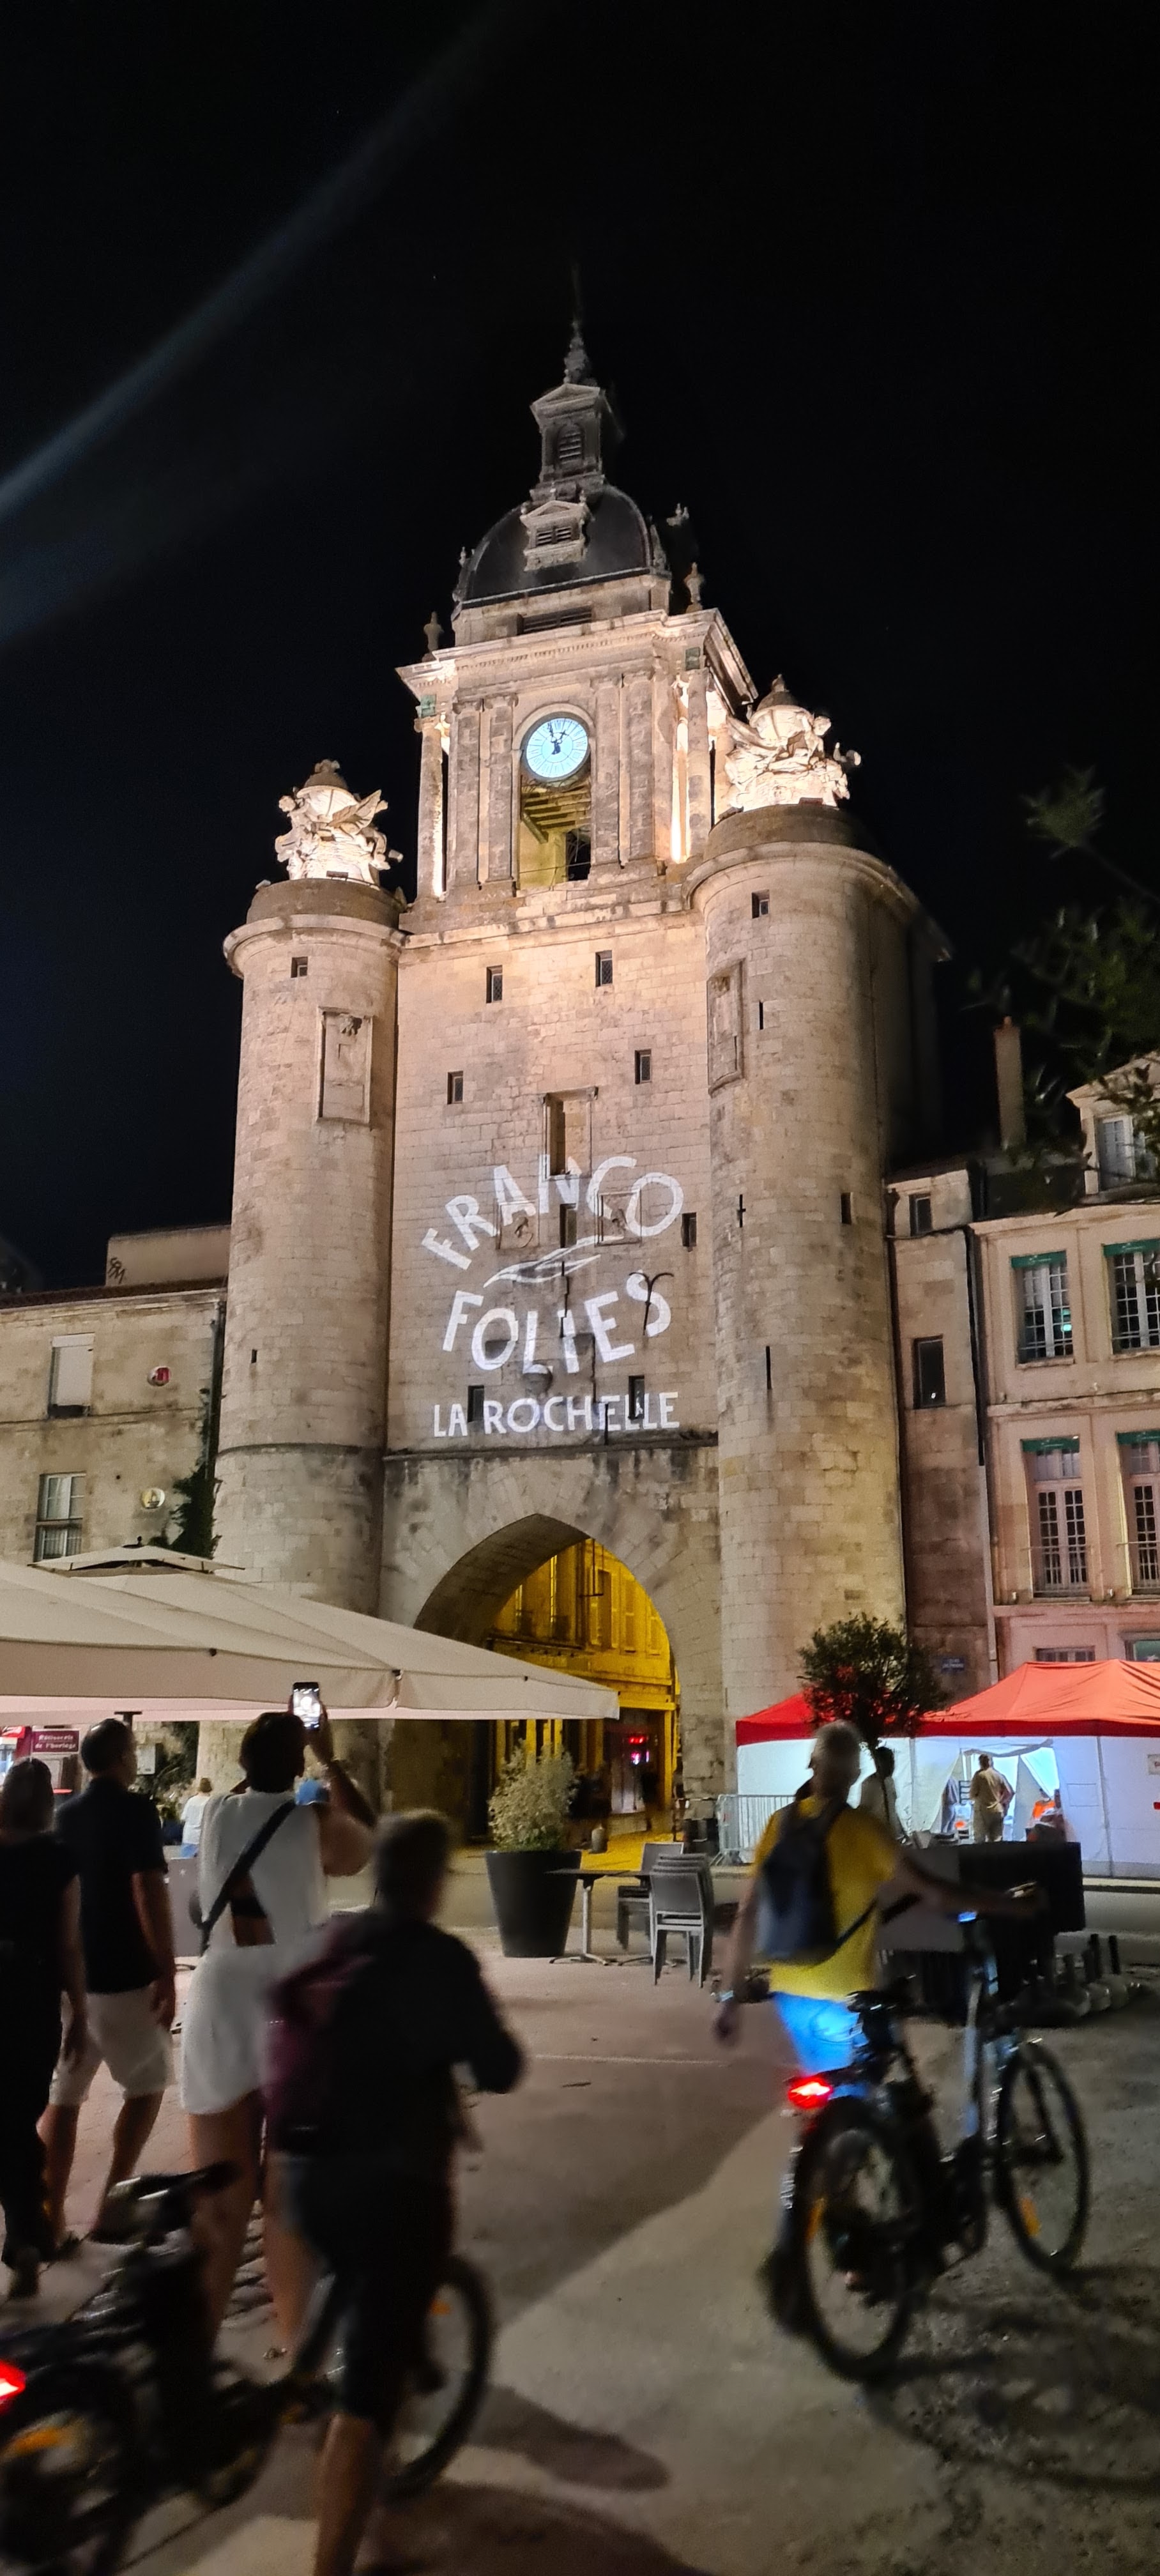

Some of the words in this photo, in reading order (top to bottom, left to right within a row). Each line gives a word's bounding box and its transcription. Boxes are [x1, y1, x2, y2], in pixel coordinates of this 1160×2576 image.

[421, 1154, 684, 1270] FRANCO
[443, 1269, 671, 1374] FOLIES
[434, 1403, 468, 1438] LA
[483, 1392, 680, 1435] ROCHELLE
